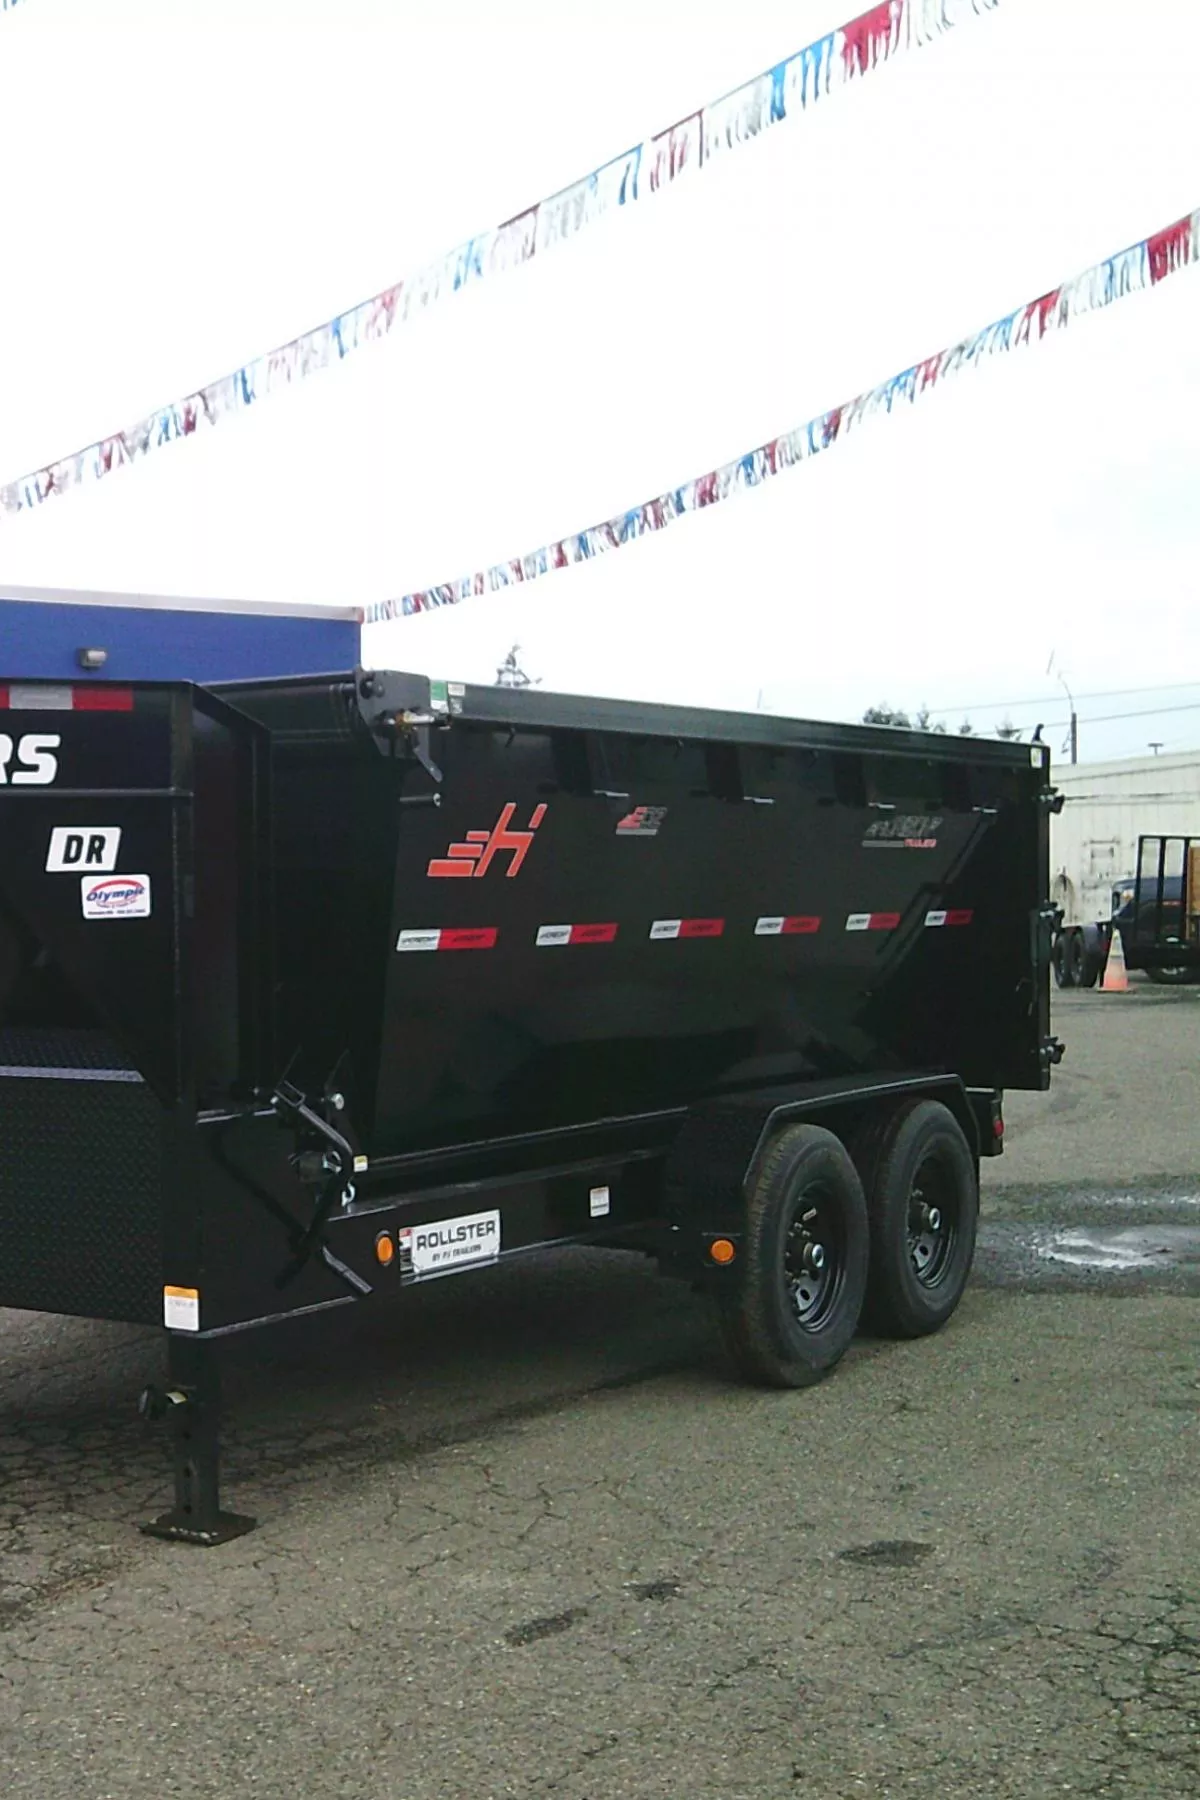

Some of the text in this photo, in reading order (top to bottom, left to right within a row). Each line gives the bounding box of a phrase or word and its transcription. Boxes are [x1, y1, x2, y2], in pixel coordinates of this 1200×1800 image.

[62, 834, 107, 865] DR
[86, 882, 146, 903] Olympic
[416, 1220, 496, 1251] ROLLSTER
